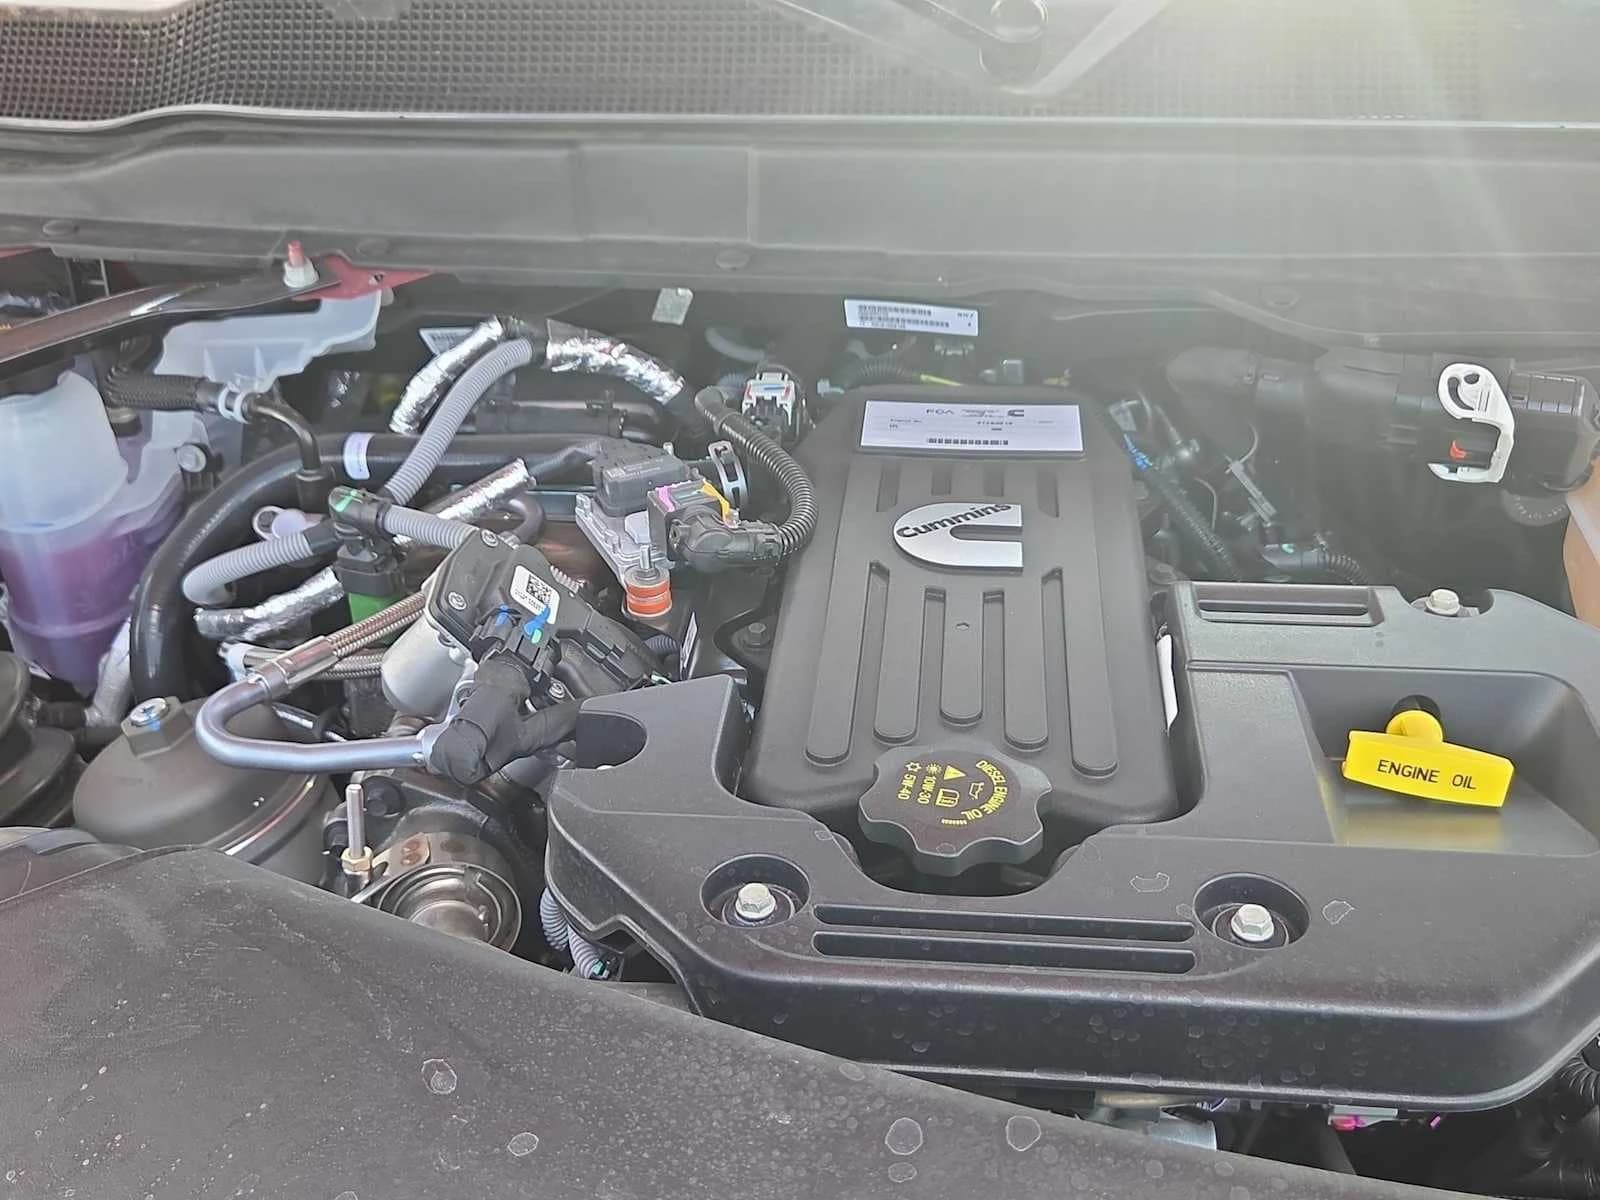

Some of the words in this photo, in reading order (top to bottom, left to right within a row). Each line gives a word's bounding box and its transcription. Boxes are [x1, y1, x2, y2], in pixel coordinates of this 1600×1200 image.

[895, 503, 1012, 538] Cummins
[897, 773, 917, 800] 5W-40
[975, 760, 1006, 785] DIESEL
[1377, 759, 1440, 783] ENGINE
[1452, 774, 1477, 790] OIL
[917, 775, 937, 804] 10W-30
[979, 786, 1008, 814] ENGINE
[961, 808, 983, 821] OIL
